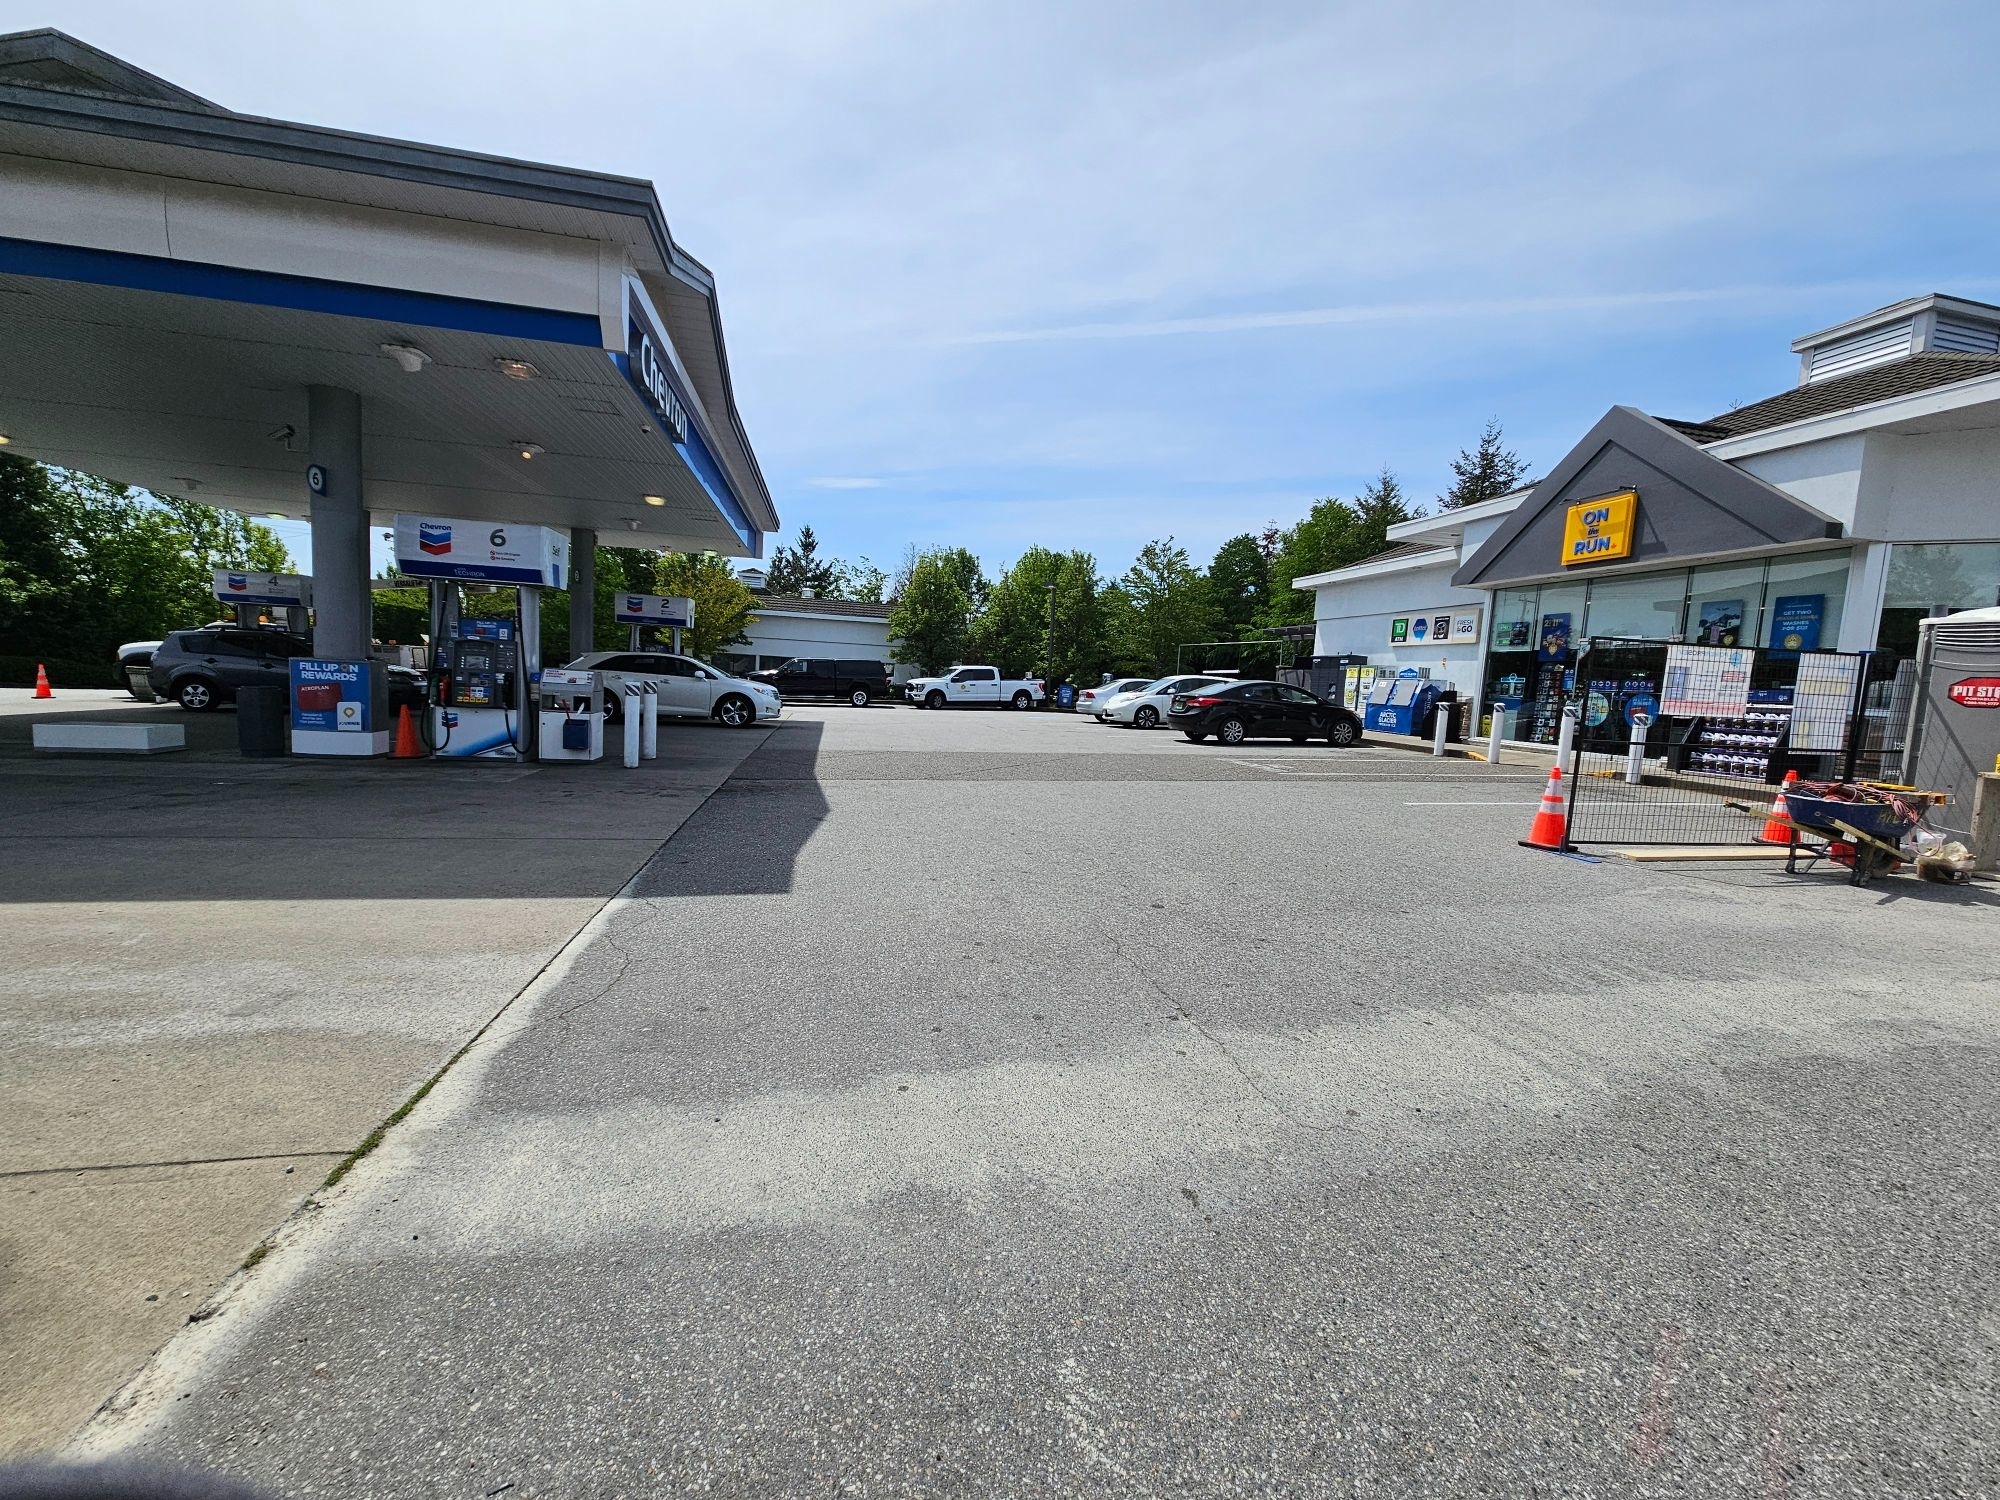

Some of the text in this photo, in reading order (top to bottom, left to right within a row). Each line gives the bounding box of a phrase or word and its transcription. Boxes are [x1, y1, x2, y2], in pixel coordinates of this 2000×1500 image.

[641, 333, 687, 445] Chevron
[312, 472, 319, 486] 6
[1583, 507, 1610, 525] ON
[419, 522, 452, 531] Chevron
[489, 528, 507, 547] 6
[1574, 536, 1611, 555] RUN
[268, 576, 279, 587] 4
[661, 599, 670, 609] 2
[1395, 622, 1406, 634] TD
[1461, 624, 1473, 633] GO
[299, 661, 321, 671] FILL
[322, 664, 339, 672] UP
[301, 671, 357, 682] REWARDS
[1952, 685, 1976, 697] PIT
[1379, 711, 1397, 719] ARCTIC
